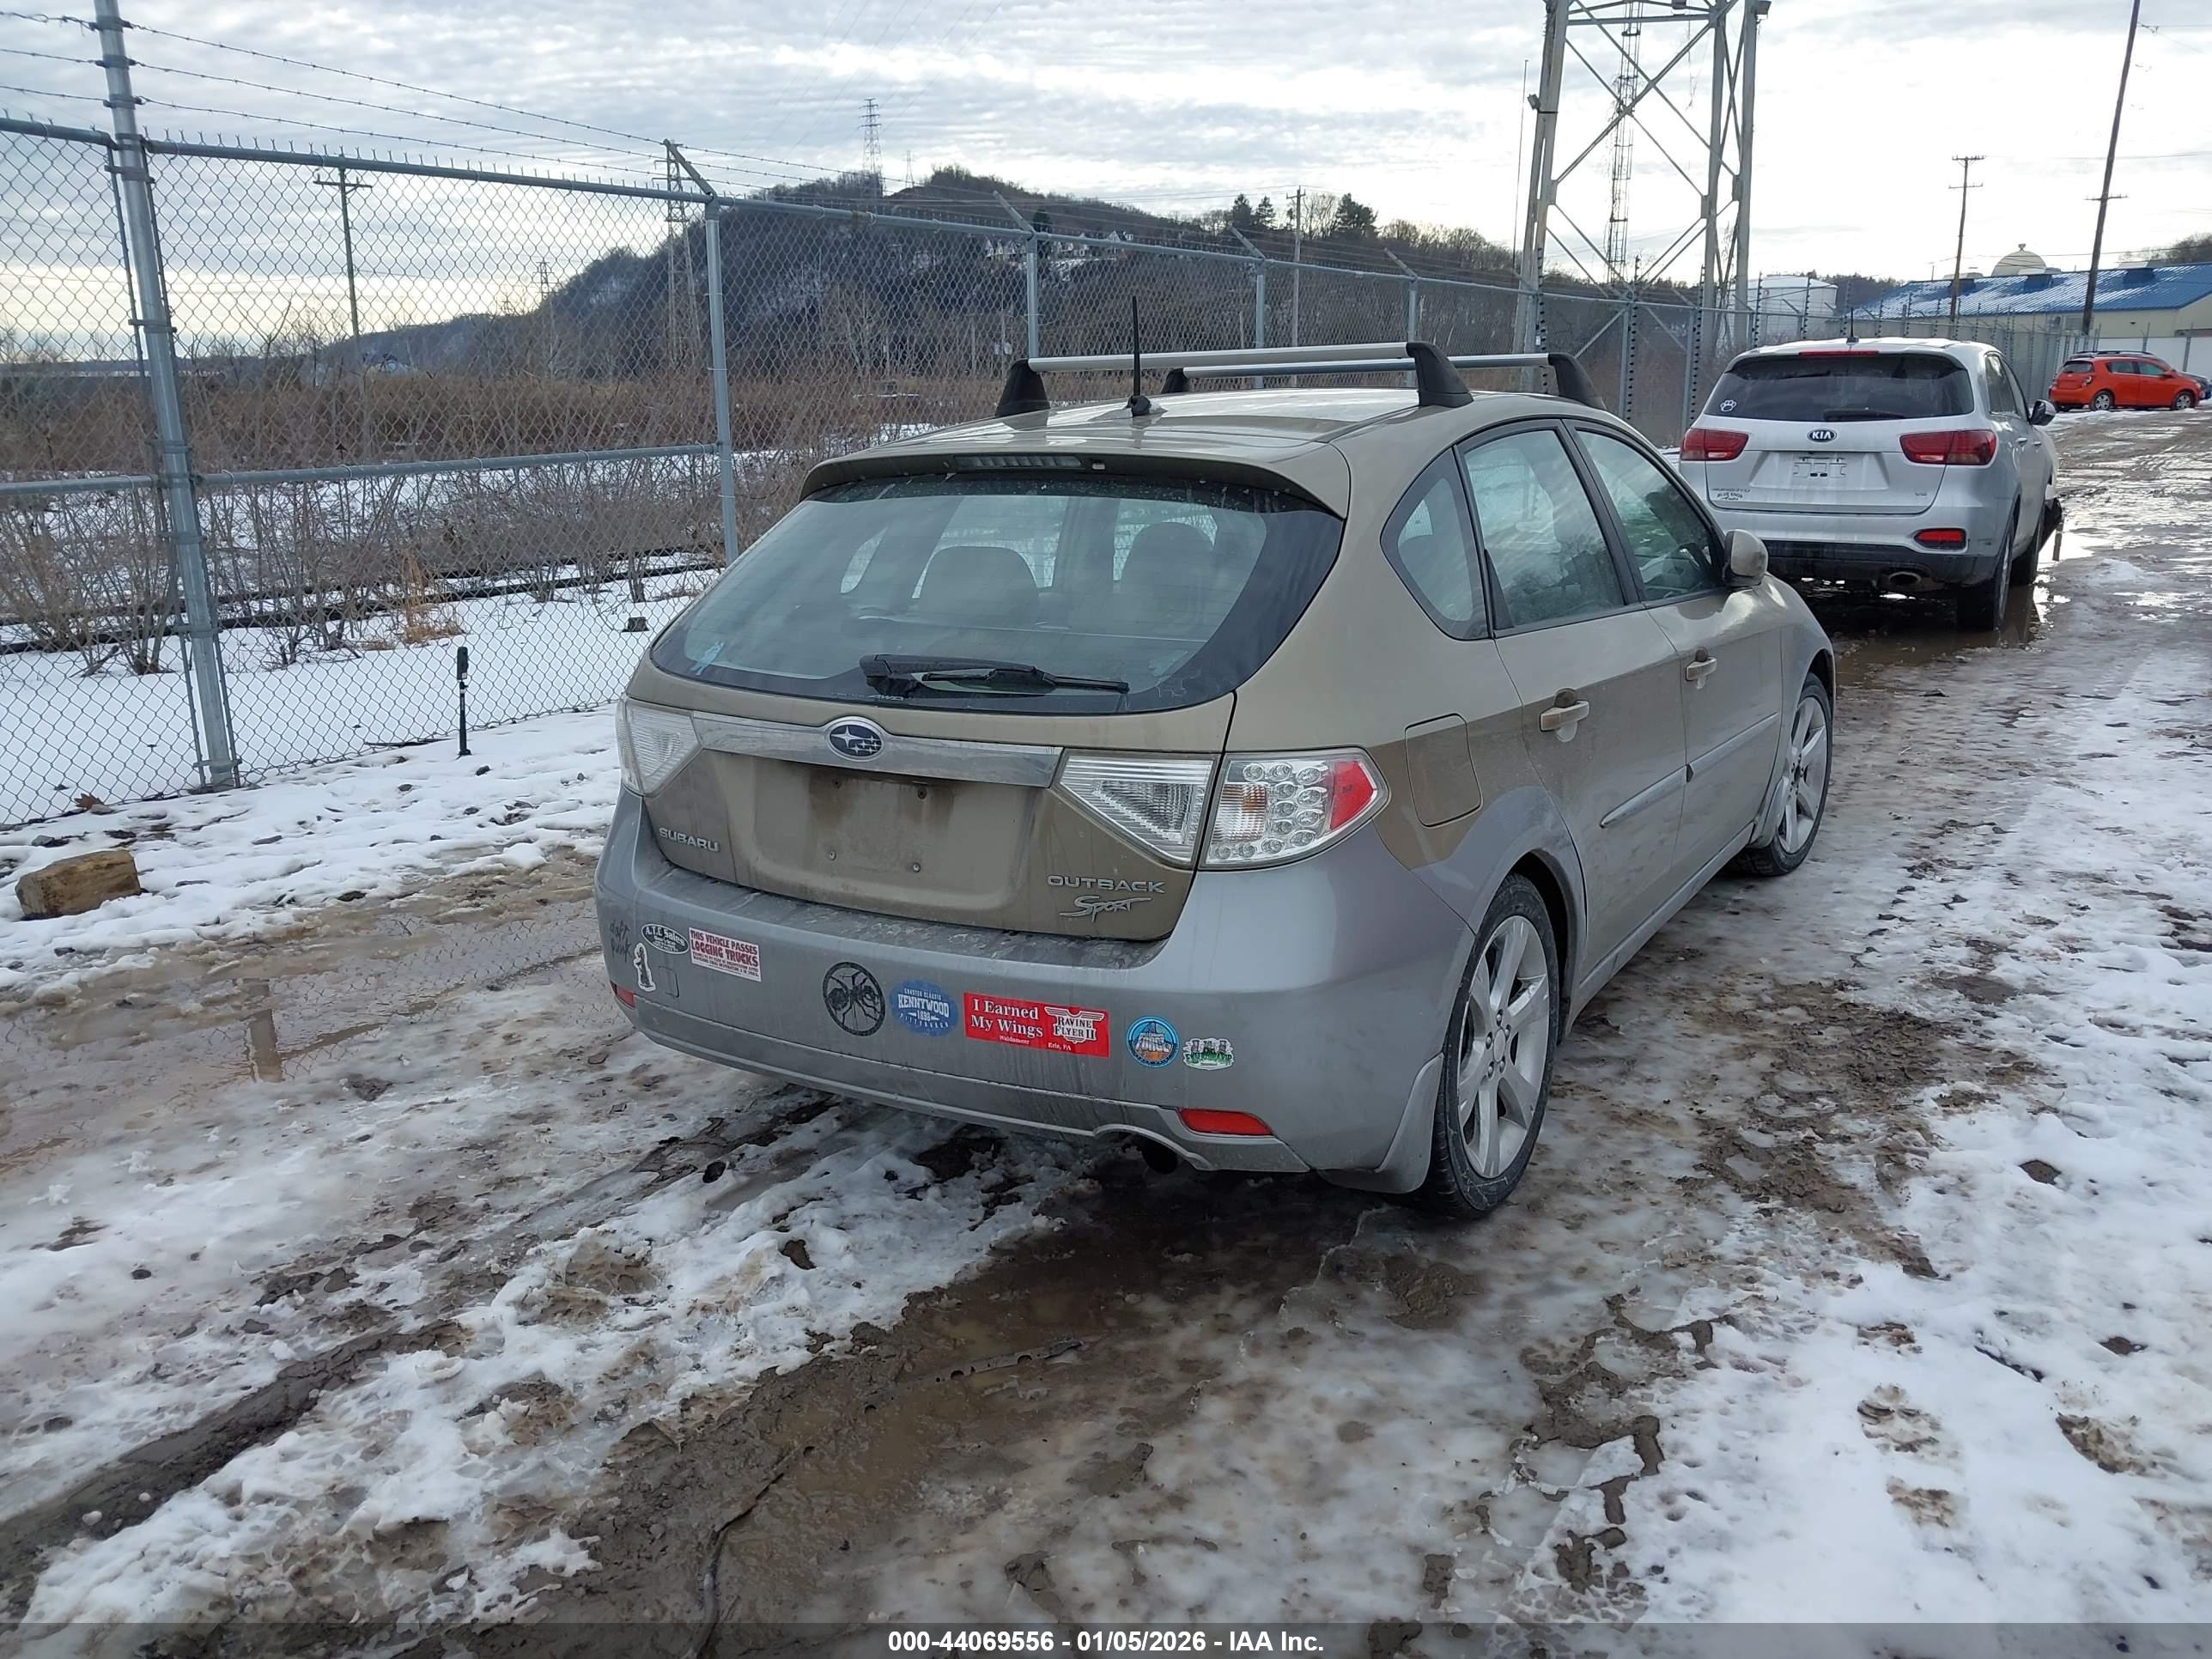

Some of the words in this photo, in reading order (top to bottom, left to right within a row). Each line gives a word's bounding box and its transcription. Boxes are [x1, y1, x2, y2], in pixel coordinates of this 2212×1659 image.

[1813, 431, 1832, 440] KIA
[659, 827, 720, 852] SUBARU
[1047, 874, 1166, 893] OUTBACK
[690, 930, 704, 941] THIS
[706, 933, 730, 948] VEHICLE
[731, 940, 757, 955] PASSES
[690, 939, 724, 958] LOGGING
[725, 949, 759, 967] TRUCKS
[897, 994, 950, 1018] KENNYWOOD
[974, 998, 980, 1012] I
[984, 1000, 1039, 1020] Earned
[970, 1014, 994, 1031] My
[997, 1018, 1043, 1039] Wings
[1054, 1024, 1085, 1037] FLYER
[1058, 1016, 1092, 1029] RAVINE
